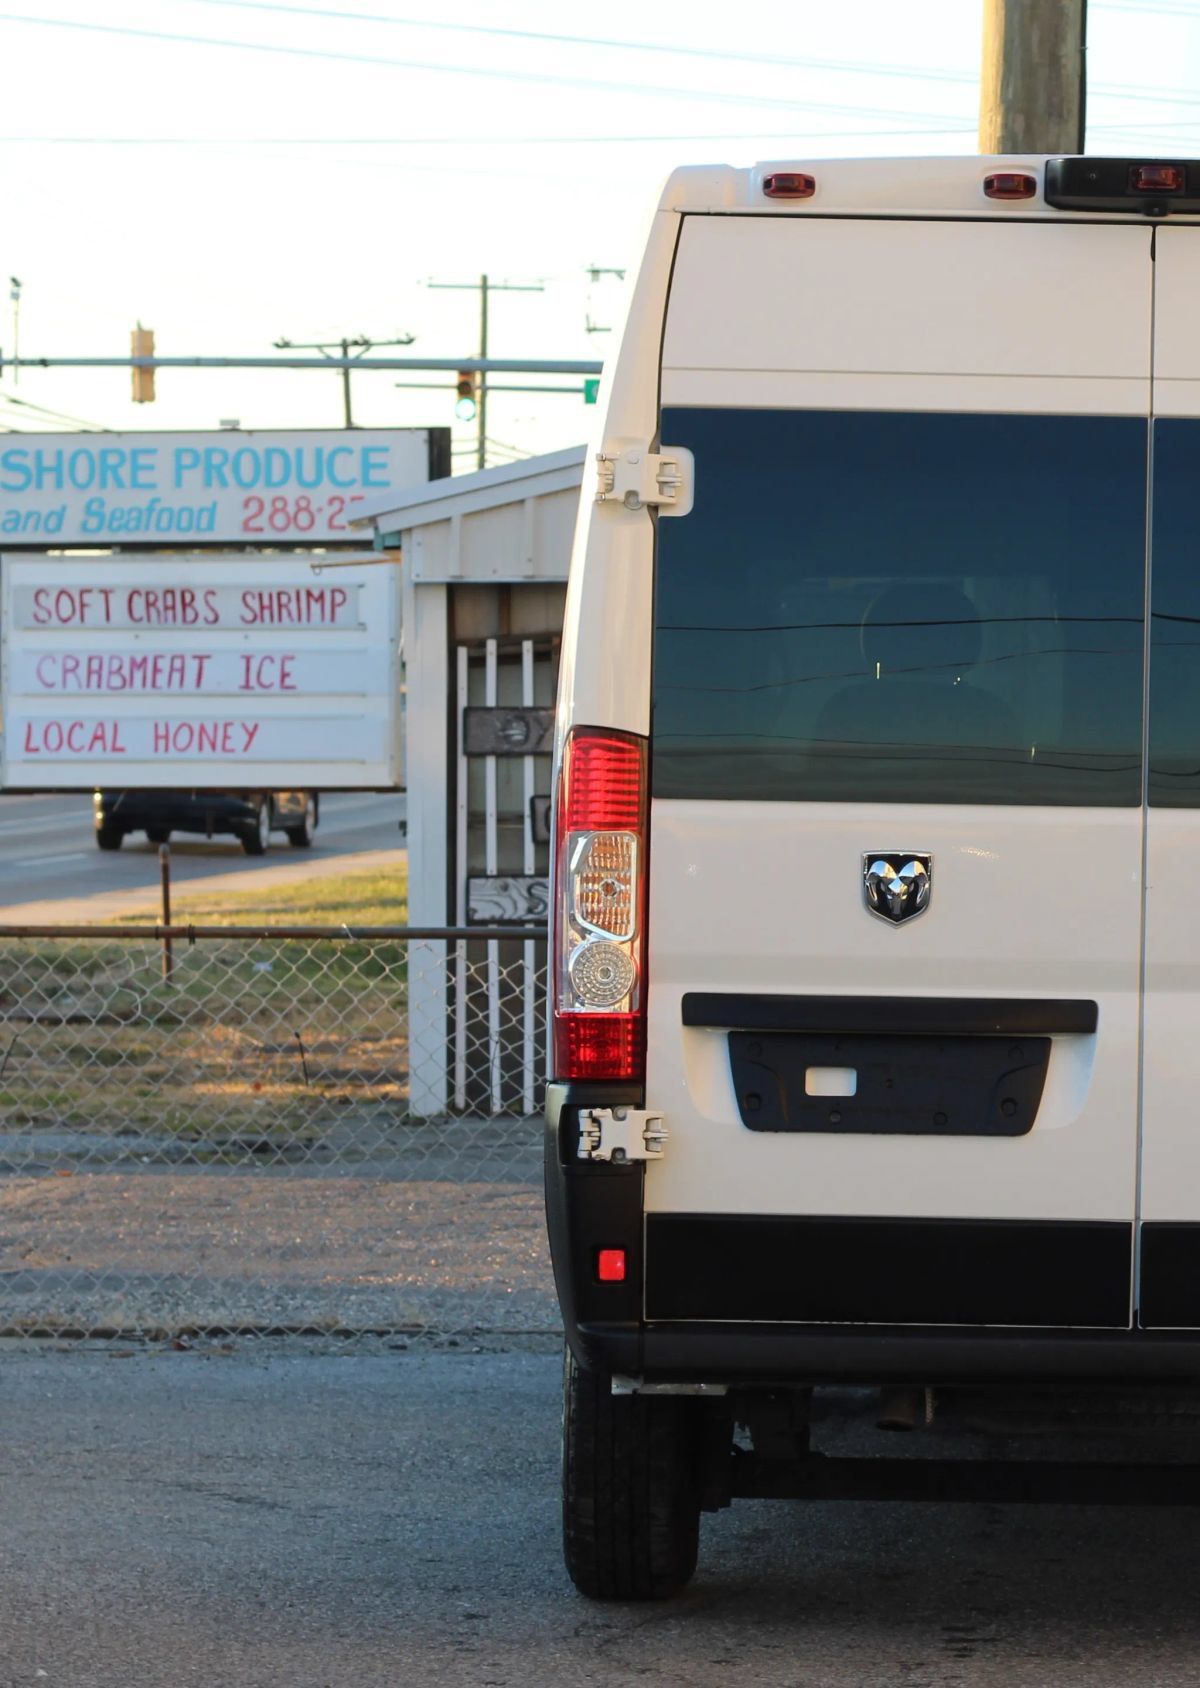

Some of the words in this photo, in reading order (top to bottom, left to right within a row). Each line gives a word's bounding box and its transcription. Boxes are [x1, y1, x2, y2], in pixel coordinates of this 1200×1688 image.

[1, 447, 158, 492] SHORE
[174, 446, 391, 490] PRODUCE
[1, 504, 68, 534] and
[80, 496, 218, 533] Seafood
[32, 588, 116, 625] SOFT
[127, 588, 220, 625] CRABS
[239, 588, 347, 625] SHRIMP
[36, 655, 211, 691] CRABMEAT
[238, 655, 297, 690] ICE
[24, 721, 126, 753] LOCAL
[153, 721, 260, 753] HONEY
